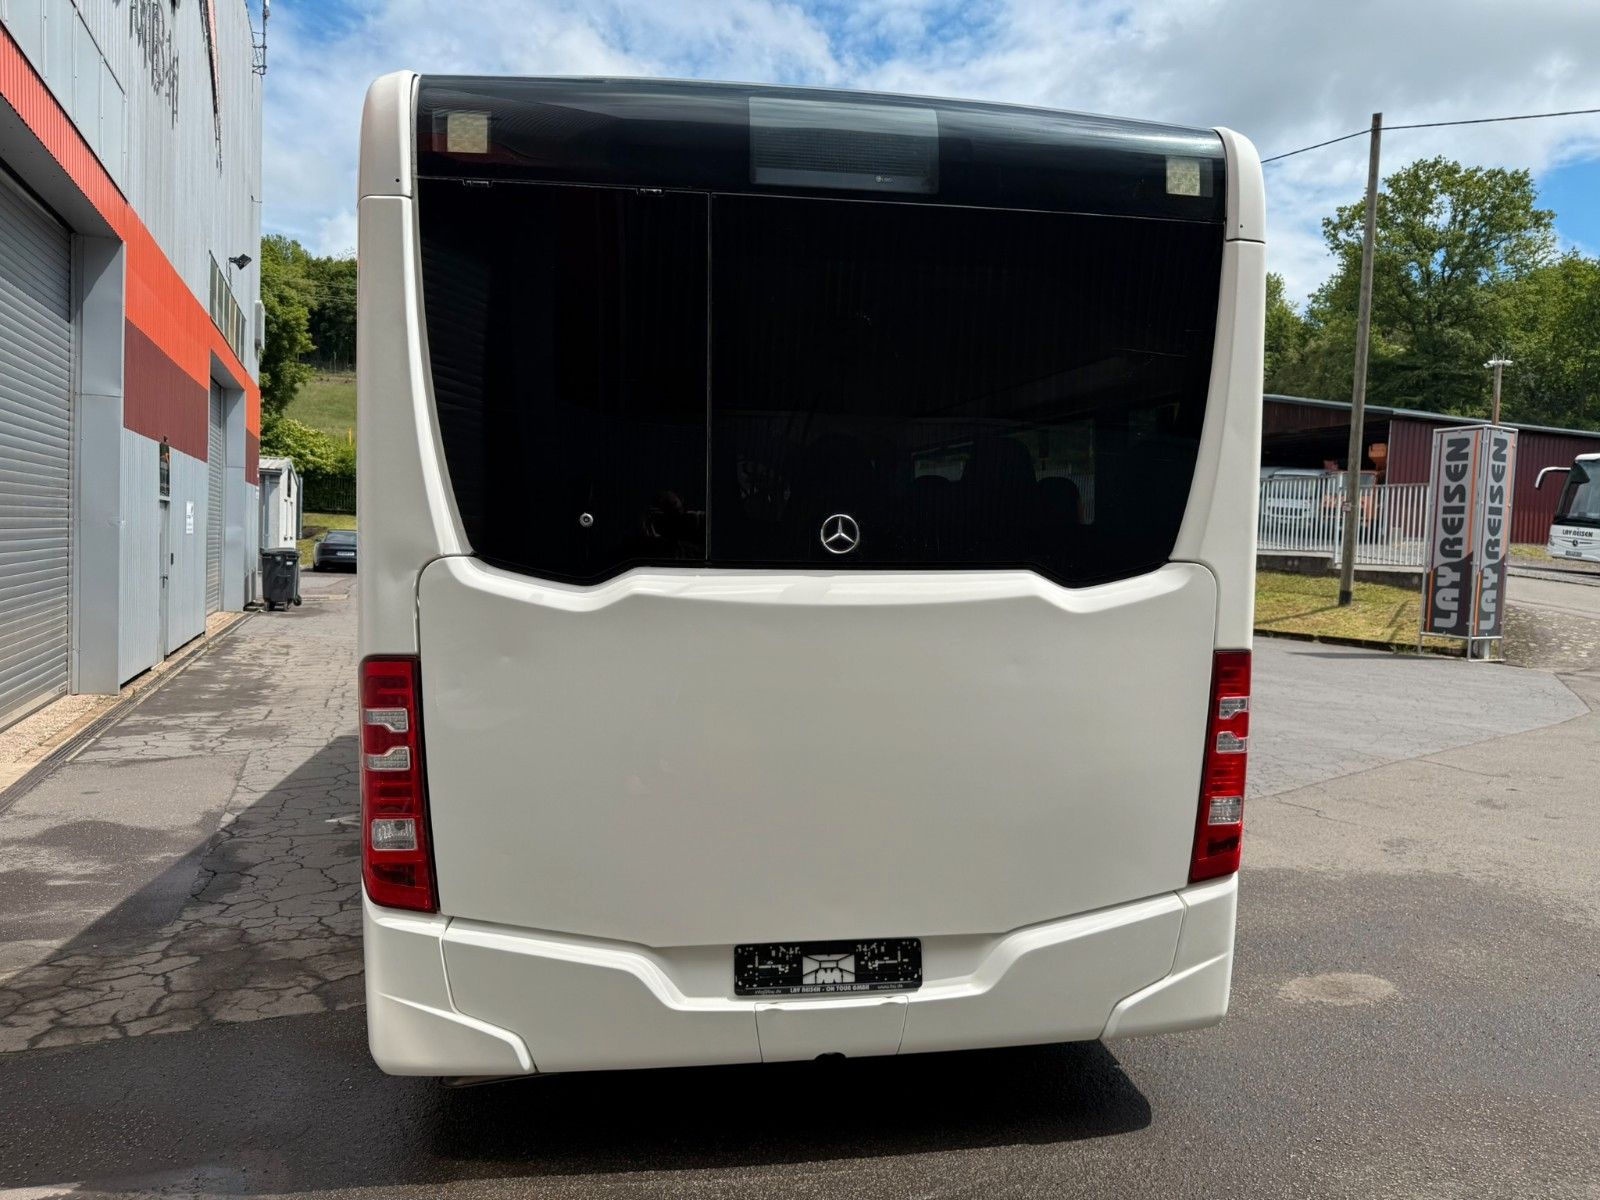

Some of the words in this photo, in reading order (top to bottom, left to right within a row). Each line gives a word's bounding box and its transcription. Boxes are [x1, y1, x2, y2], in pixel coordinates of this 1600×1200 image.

[1439, 437, 1471, 559] REISEN
[1485, 437, 1508, 561] REISEN
[1434, 565, 1461, 629] LAY
[1479, 567, 1498, 630] LAY
